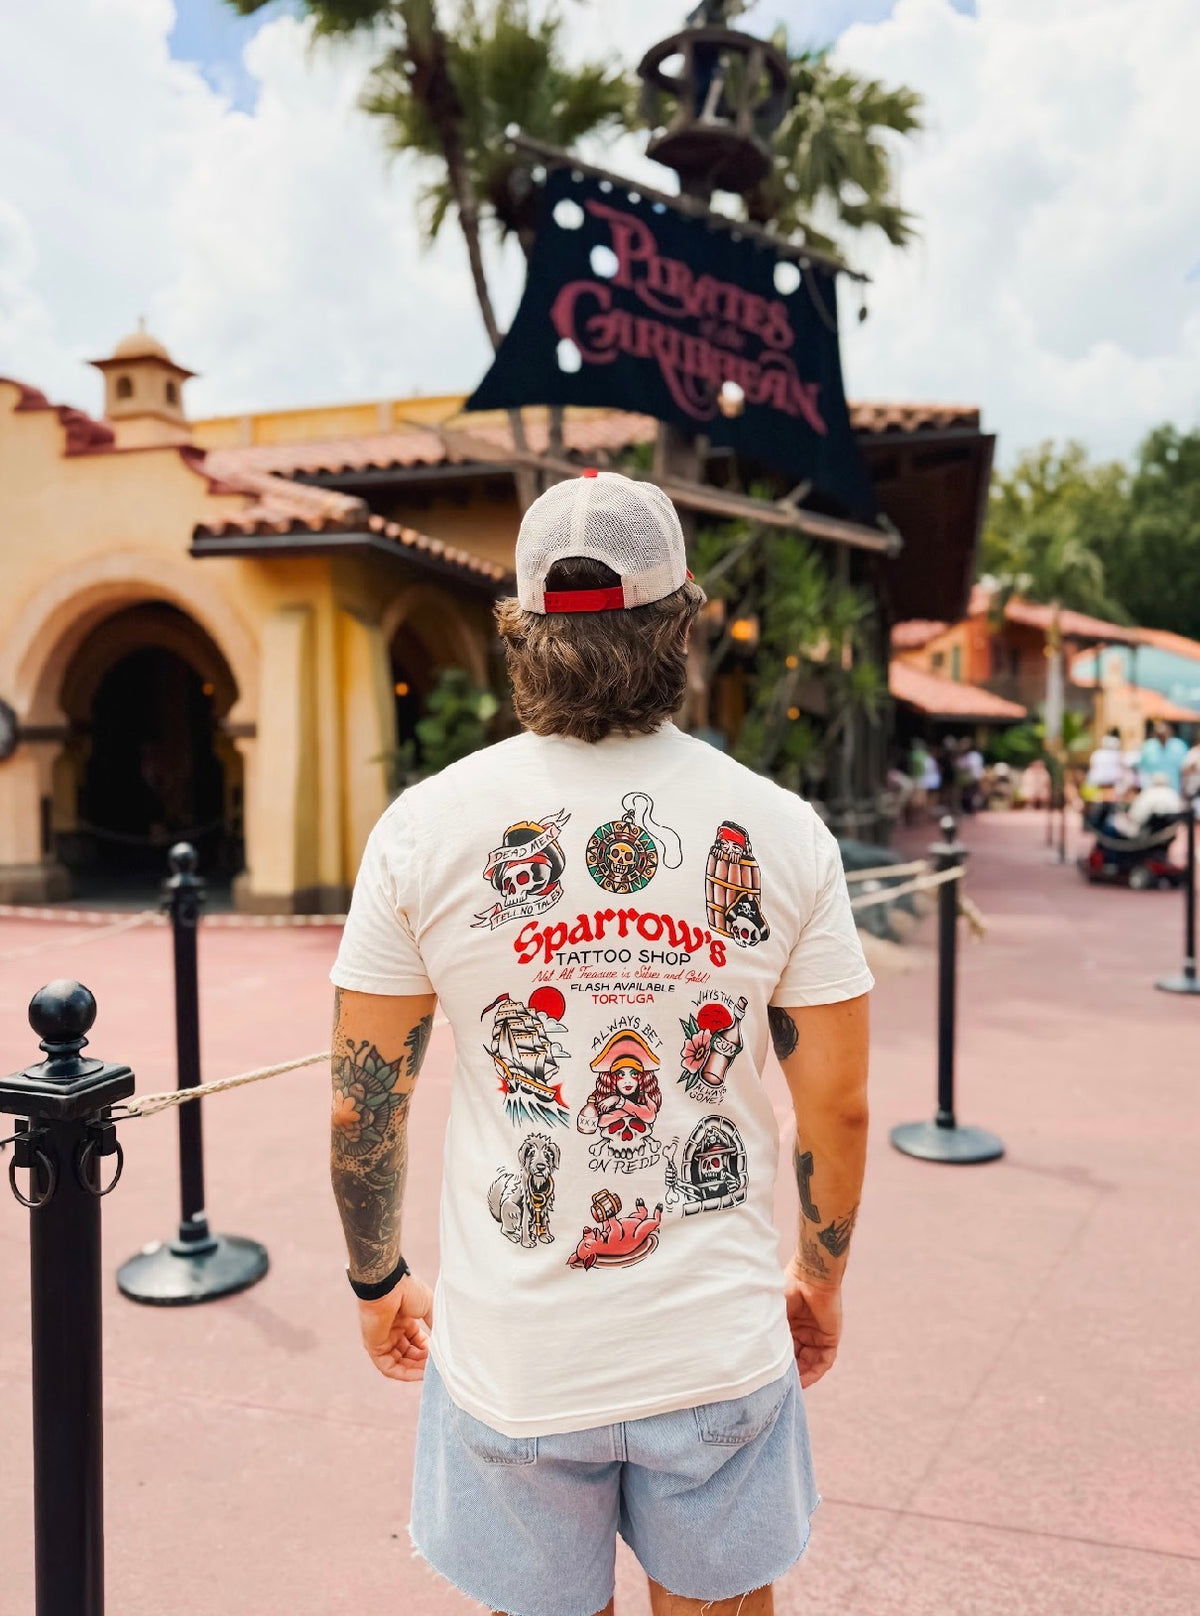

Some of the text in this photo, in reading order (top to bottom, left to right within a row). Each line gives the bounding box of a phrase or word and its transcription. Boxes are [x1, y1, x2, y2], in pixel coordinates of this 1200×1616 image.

[584, 199, 795, 351] PIRATES
[494, 828, 555, 863] DEAD MEN
[493, 890, 561, 924] TELL NO TALES
[514, 908, 726, 967] Sparrow's
[556, 949, 691, 965] TATTOO SHOP
[532, 964, 711, 984] Not All Treasure is Silver and Gold!
[571, 982, 675, 992] FLASH AVAILABLE
[592, 994, 655, 1005] TORTUGA
[720, 991, 735, 1009] THE
[591, 1015, 664, 1051] ALWAYS BET
[693, 1083, 727, 1096] ALWAYS
[588, 1154, 661, 1175] ON REDD
